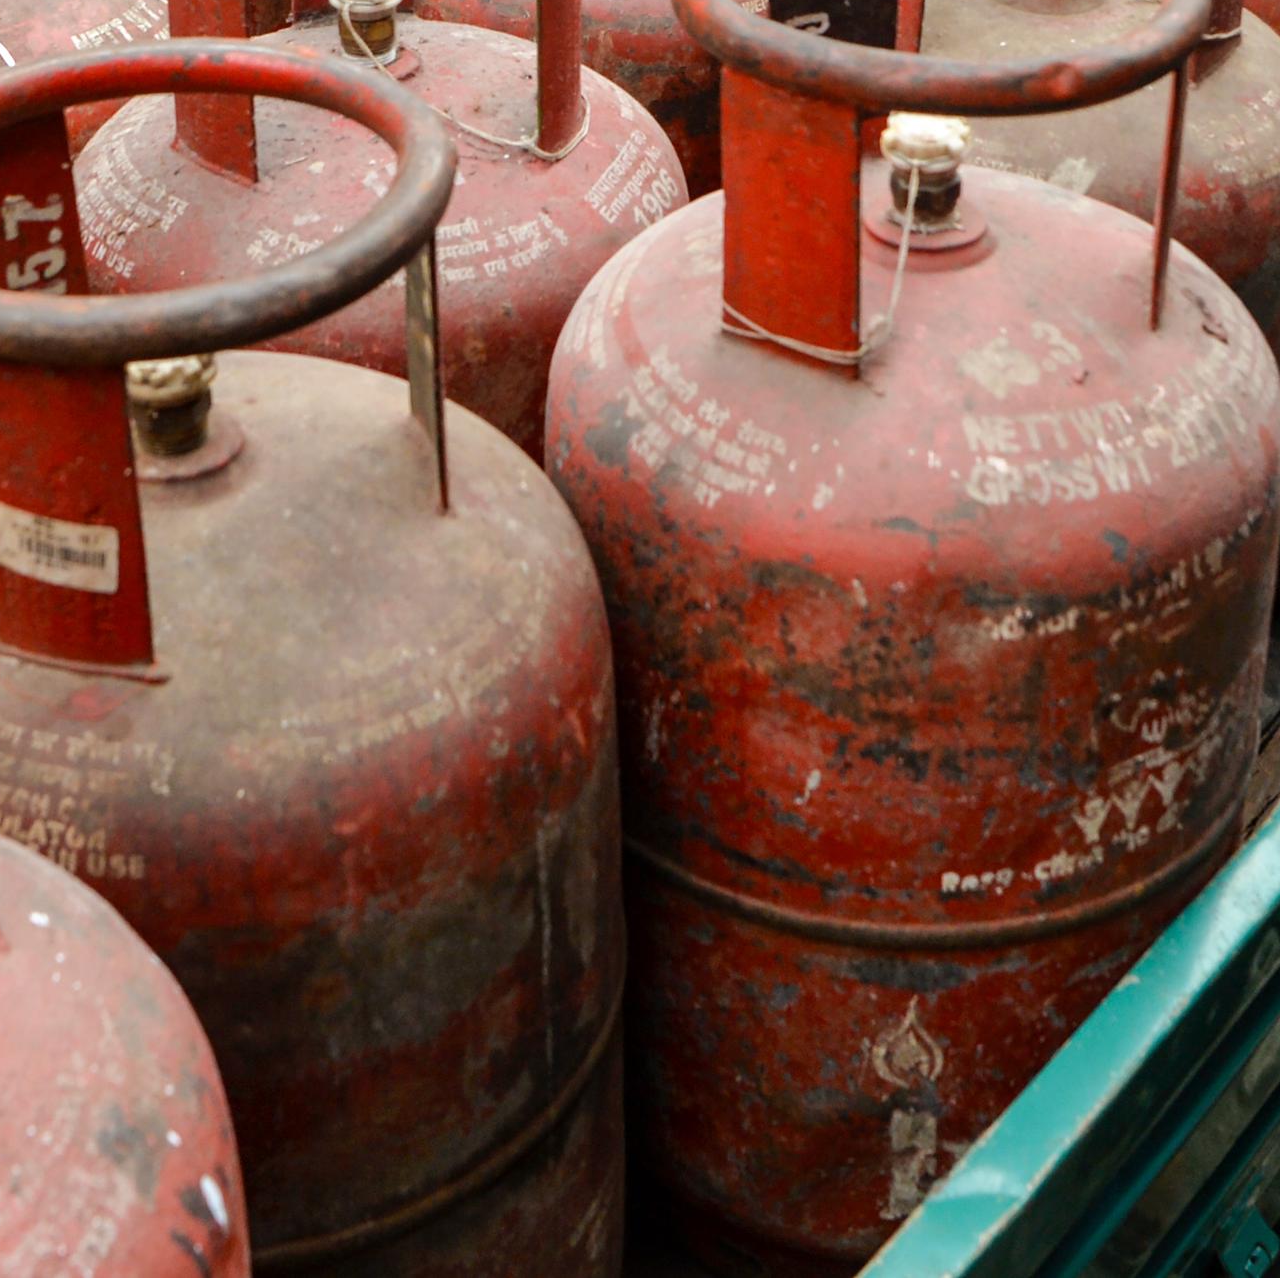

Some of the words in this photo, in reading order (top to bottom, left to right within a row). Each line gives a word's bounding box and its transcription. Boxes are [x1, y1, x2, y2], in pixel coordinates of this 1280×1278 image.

[633, 168, 679, 226] 1906
[1, 194, 68, 296] 5.7
[106, 250, 136, 279] USE
